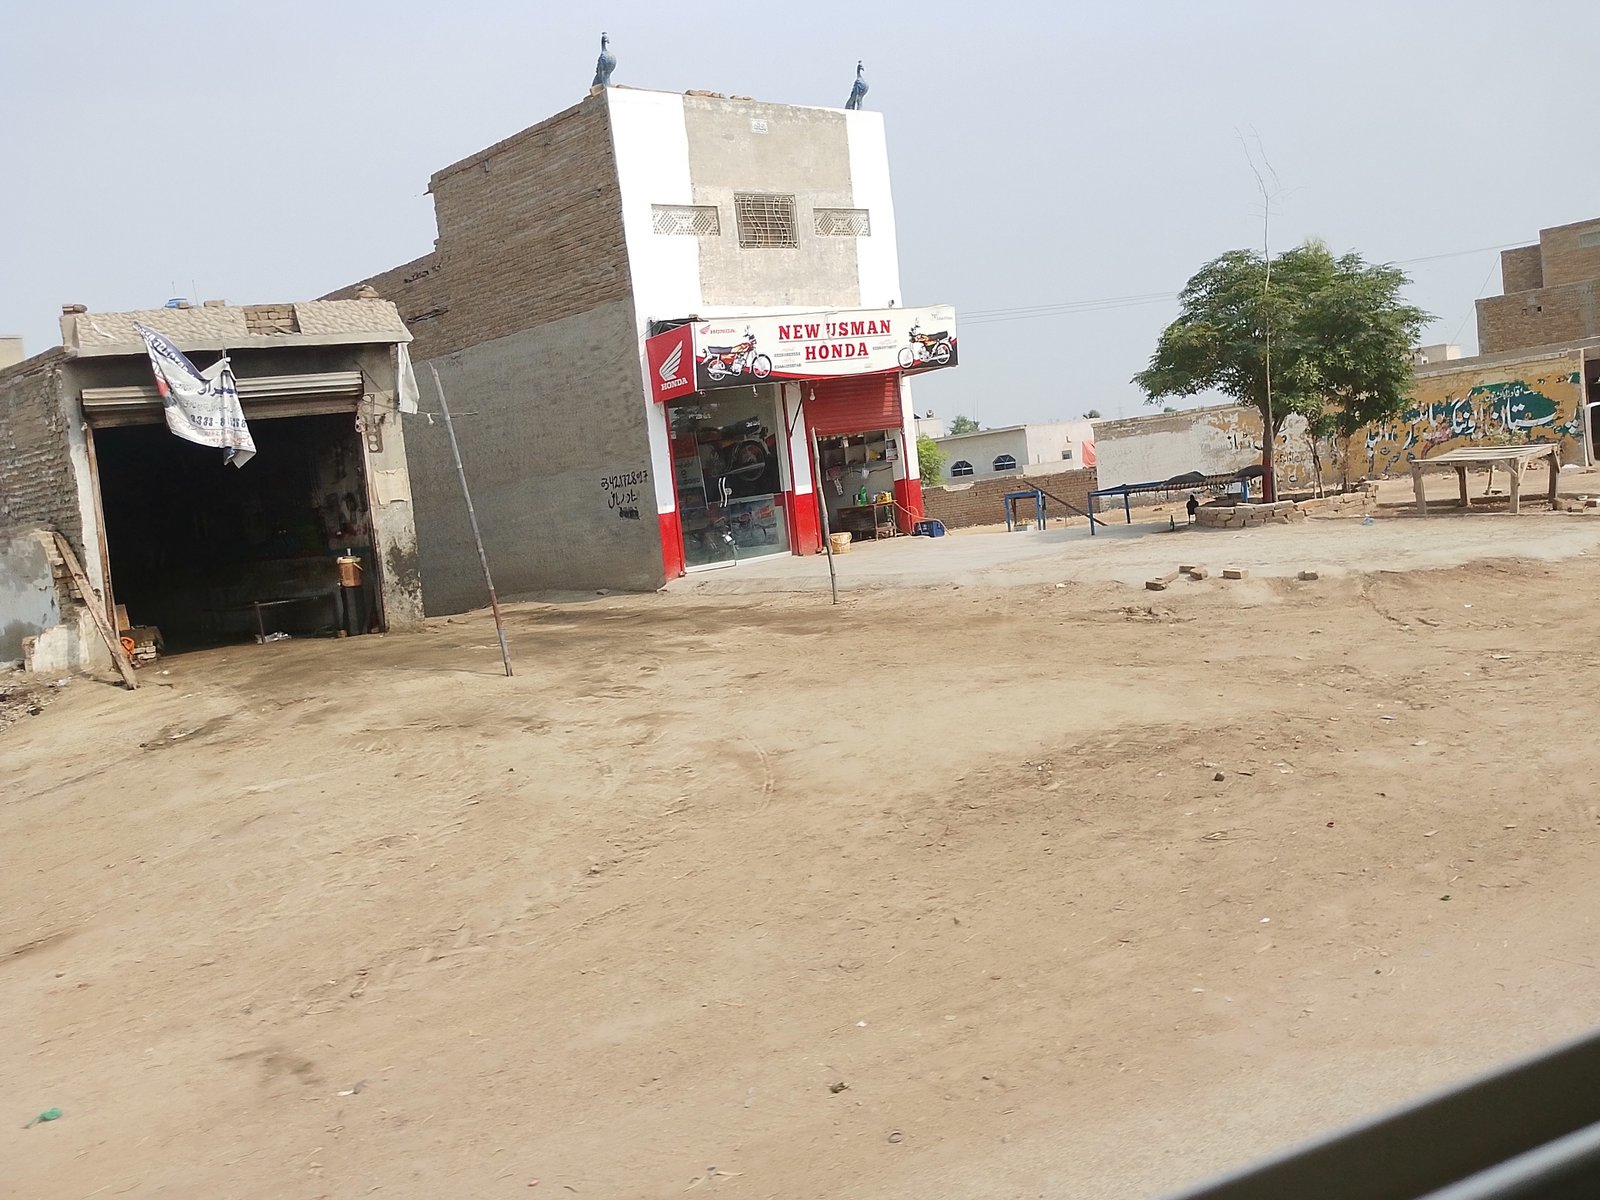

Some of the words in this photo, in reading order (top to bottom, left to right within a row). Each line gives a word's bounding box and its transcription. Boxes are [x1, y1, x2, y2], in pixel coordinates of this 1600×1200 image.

[778, 324, 820, 340] NEW
[825, 320, 891, 337] USMAN
[805, 342, 869, 360] HONDA
[660, 377, 688, 391] HONDA
